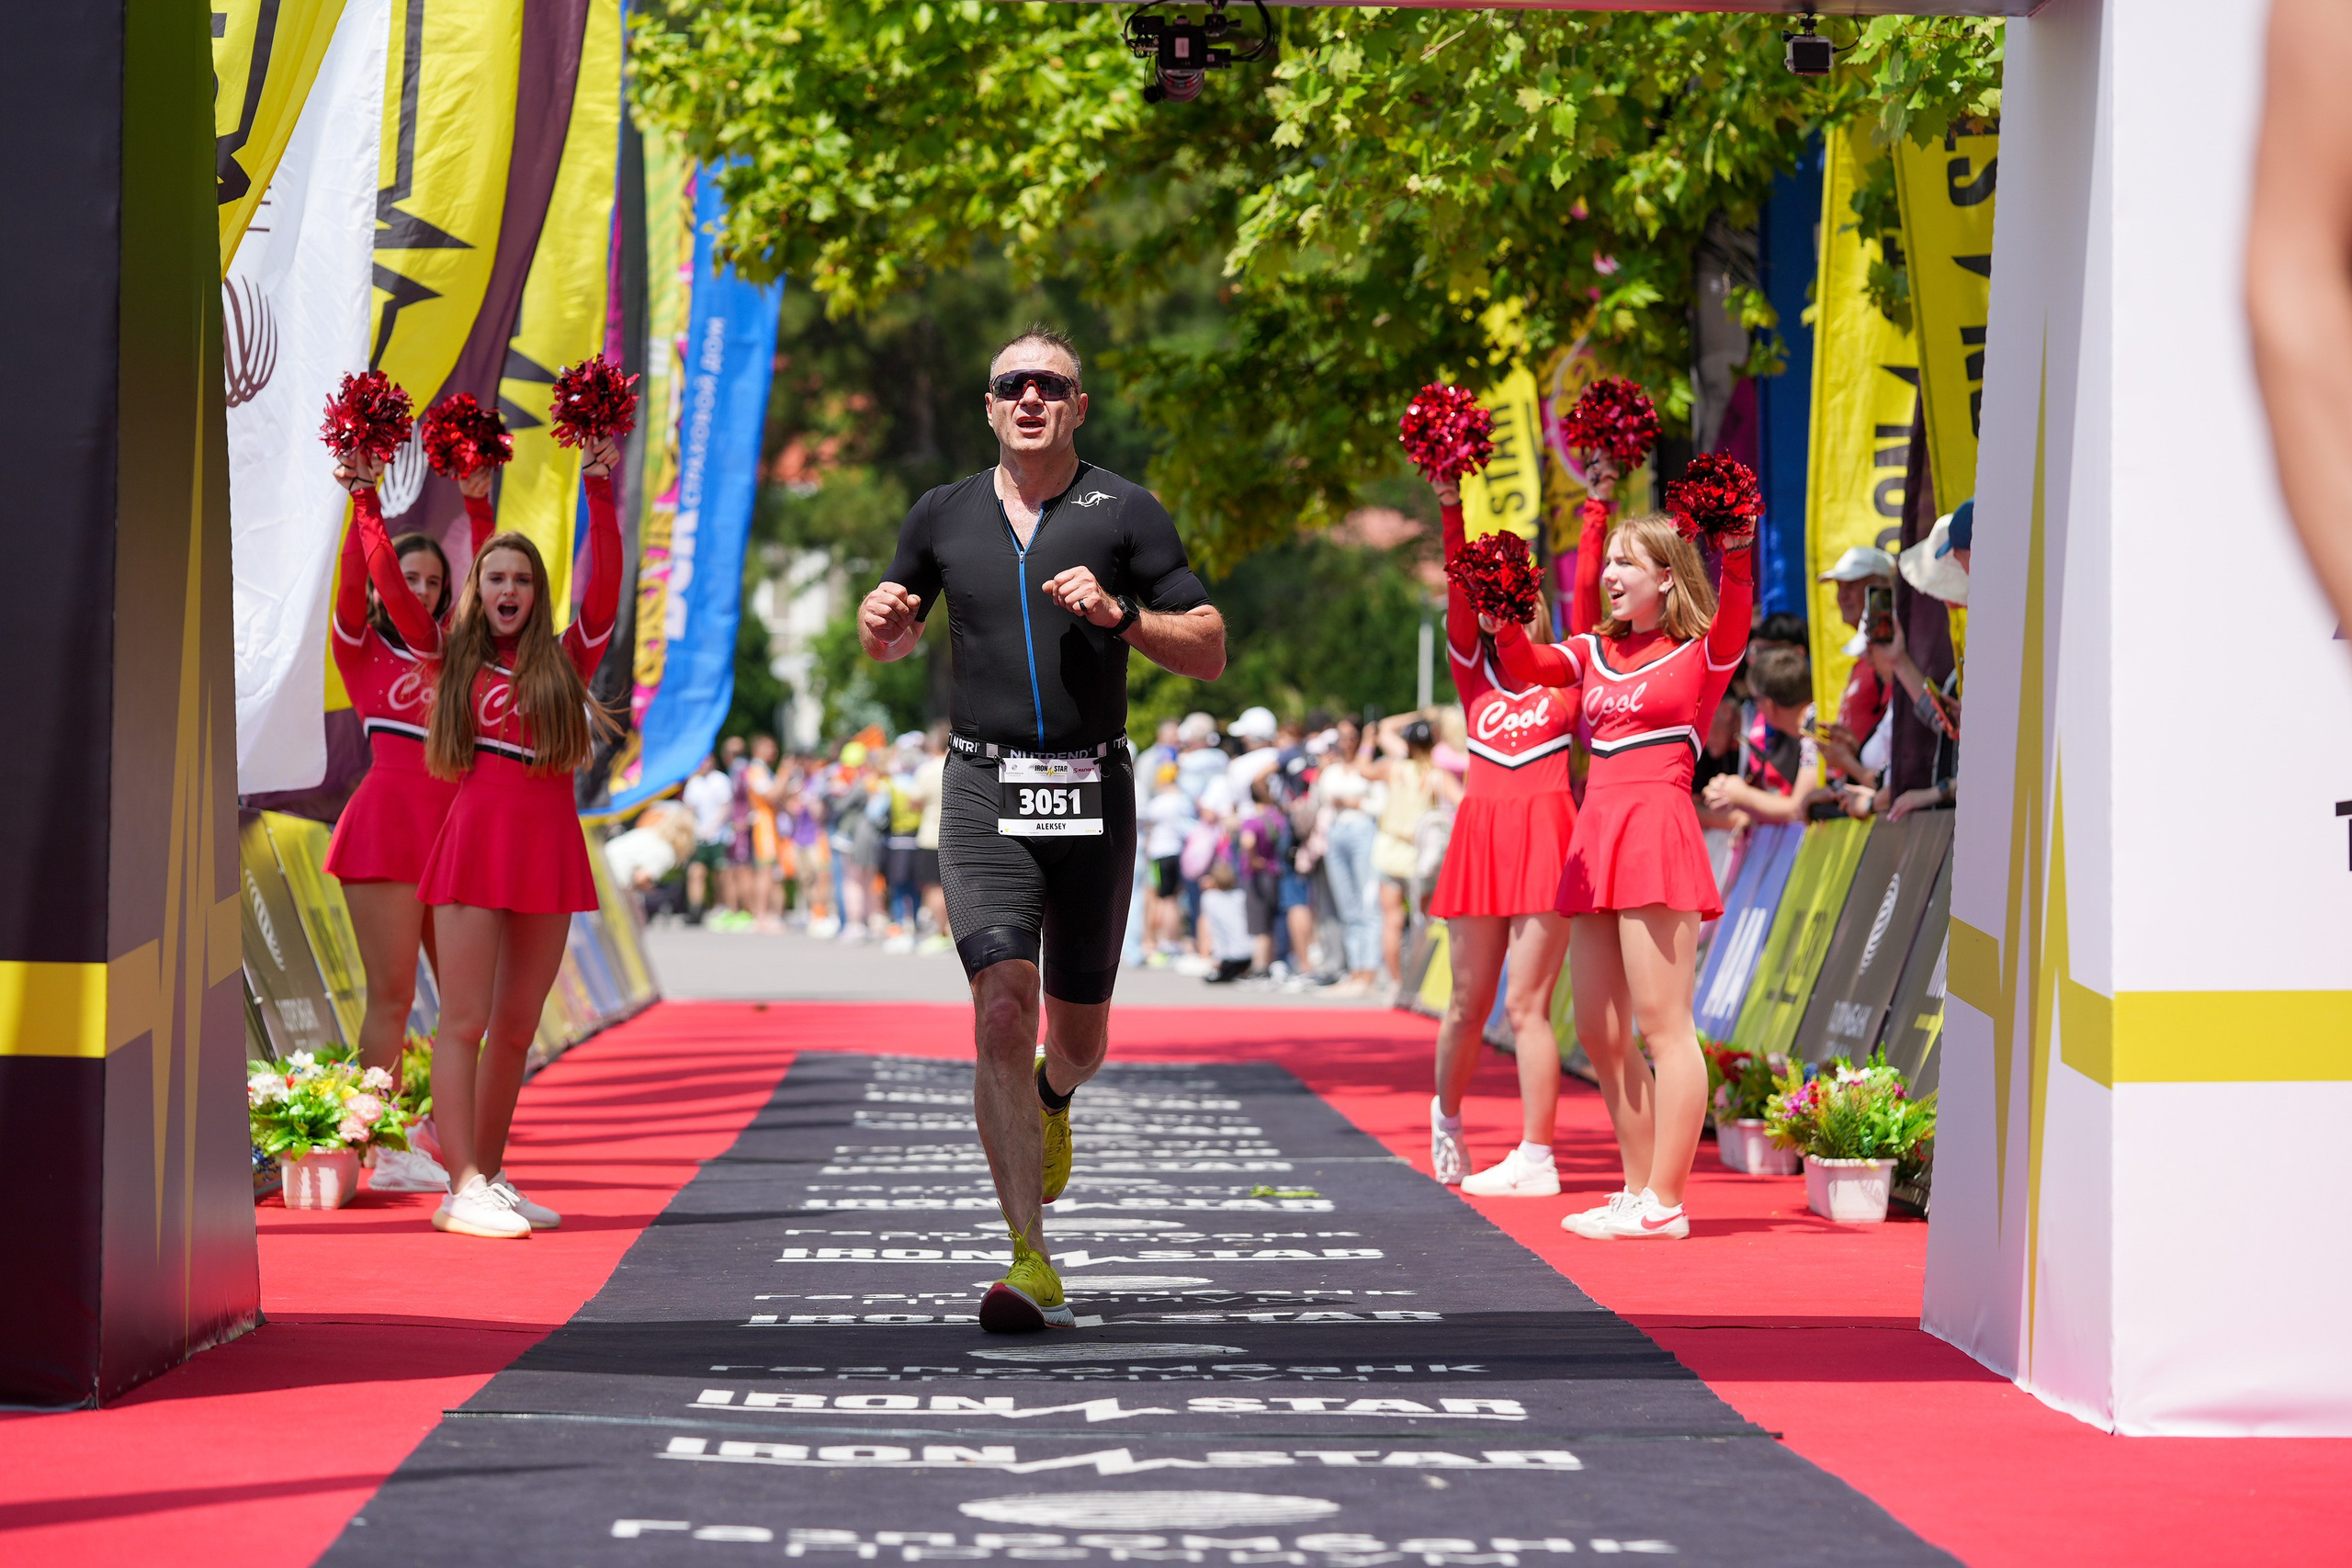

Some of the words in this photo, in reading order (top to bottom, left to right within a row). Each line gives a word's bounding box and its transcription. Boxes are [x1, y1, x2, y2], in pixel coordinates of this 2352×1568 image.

[699, 316, 727, 375] ДОМ
[388, 671, 435, 711] Co
[1583, 681, 1647, 727] Cool
[1476, 696, 1550, 740] Cool
[1054, 764, 1068, 773] STAR
[1019, 788, 1081, 816] 3051
[1035, 822, 1067, 830] ALEKSEY
[782, 1247, 1013, 1260] IRON
[1137, 1247, 1385, 1258] STAR
[1160, 1311, 1443, 1322] STAR
[696, 1389, 1013, 1410] IRON
[1187, 1396, 1529, 1416] STAR
[665, 1437, 1016, 1461] IRON
[1205, 1450, 1581, 1468] STAR
